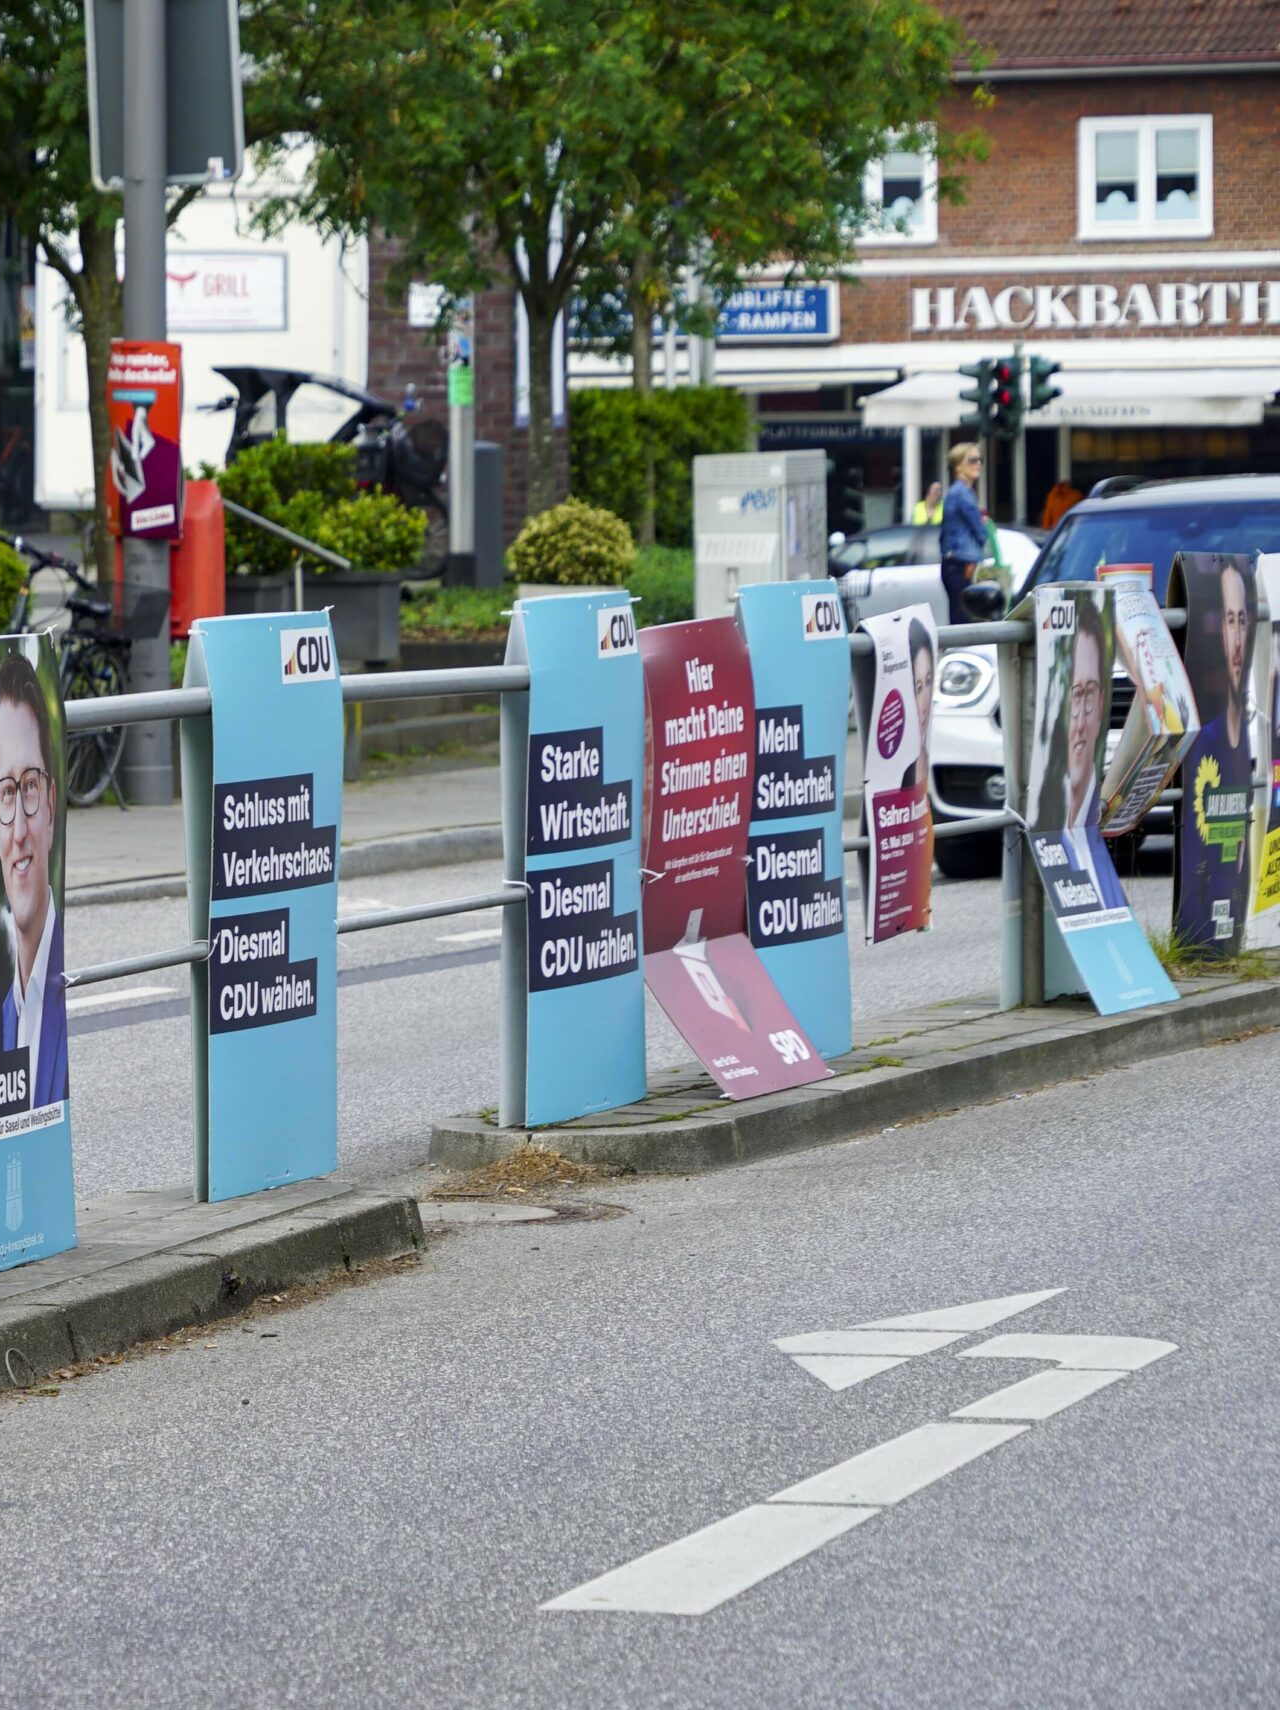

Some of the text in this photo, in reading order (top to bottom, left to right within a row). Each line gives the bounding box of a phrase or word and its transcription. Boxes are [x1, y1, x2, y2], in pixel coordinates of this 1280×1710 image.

[203, 273, 250, 298] GRILL
[738, 311, 816, 330] RAMPEN
[610, 612, 634, 648] CDU
[815, 600, 841, 632] CDU
[1050, 606, 1074, 629] CDU
[297, 634, 332, 675] CDU
[685, 657, 714, 694] Hier
[665, 700, 744, 746] macht Deine
[759, 717, 800, 755] Mehr
[540, 742, 599, 783] Starke
[661, 749, 748, 796] Stimme einen
[757, 765, 835, 810] Sicherheit.
[223, 787, 310, 831] Schluss mit
[540, 792, 630, 842] Wirtschaft.
[662, 792, 740, 843] Unterschied.
[878, 804, 910, 829] Sahra
[223, 842, 333, 888] Verkehrschaos.
[756, 839, 822, 881] Diesmal
[1034, 838, 1069, 868] Sören
[540, 873, 611, 919] Diesmal
[759, 896, 799, 936] CDU
[800, 890, 843, 931] wählen.
[1053, 879, 1098, 909] Niehaus
[220, 921, 285, 965] Diesmal
[540, 928, 636, 978] CDU wählen.
[220, 974, 314, 1020] CDU wählen.
[768, 1029, 810, 1065] SPD
[4, 1118, 20, 1135] Sasel
[20, 1116, 30, 1131] und
[30, 1106, 62, 1130] Wellingsbüttel
